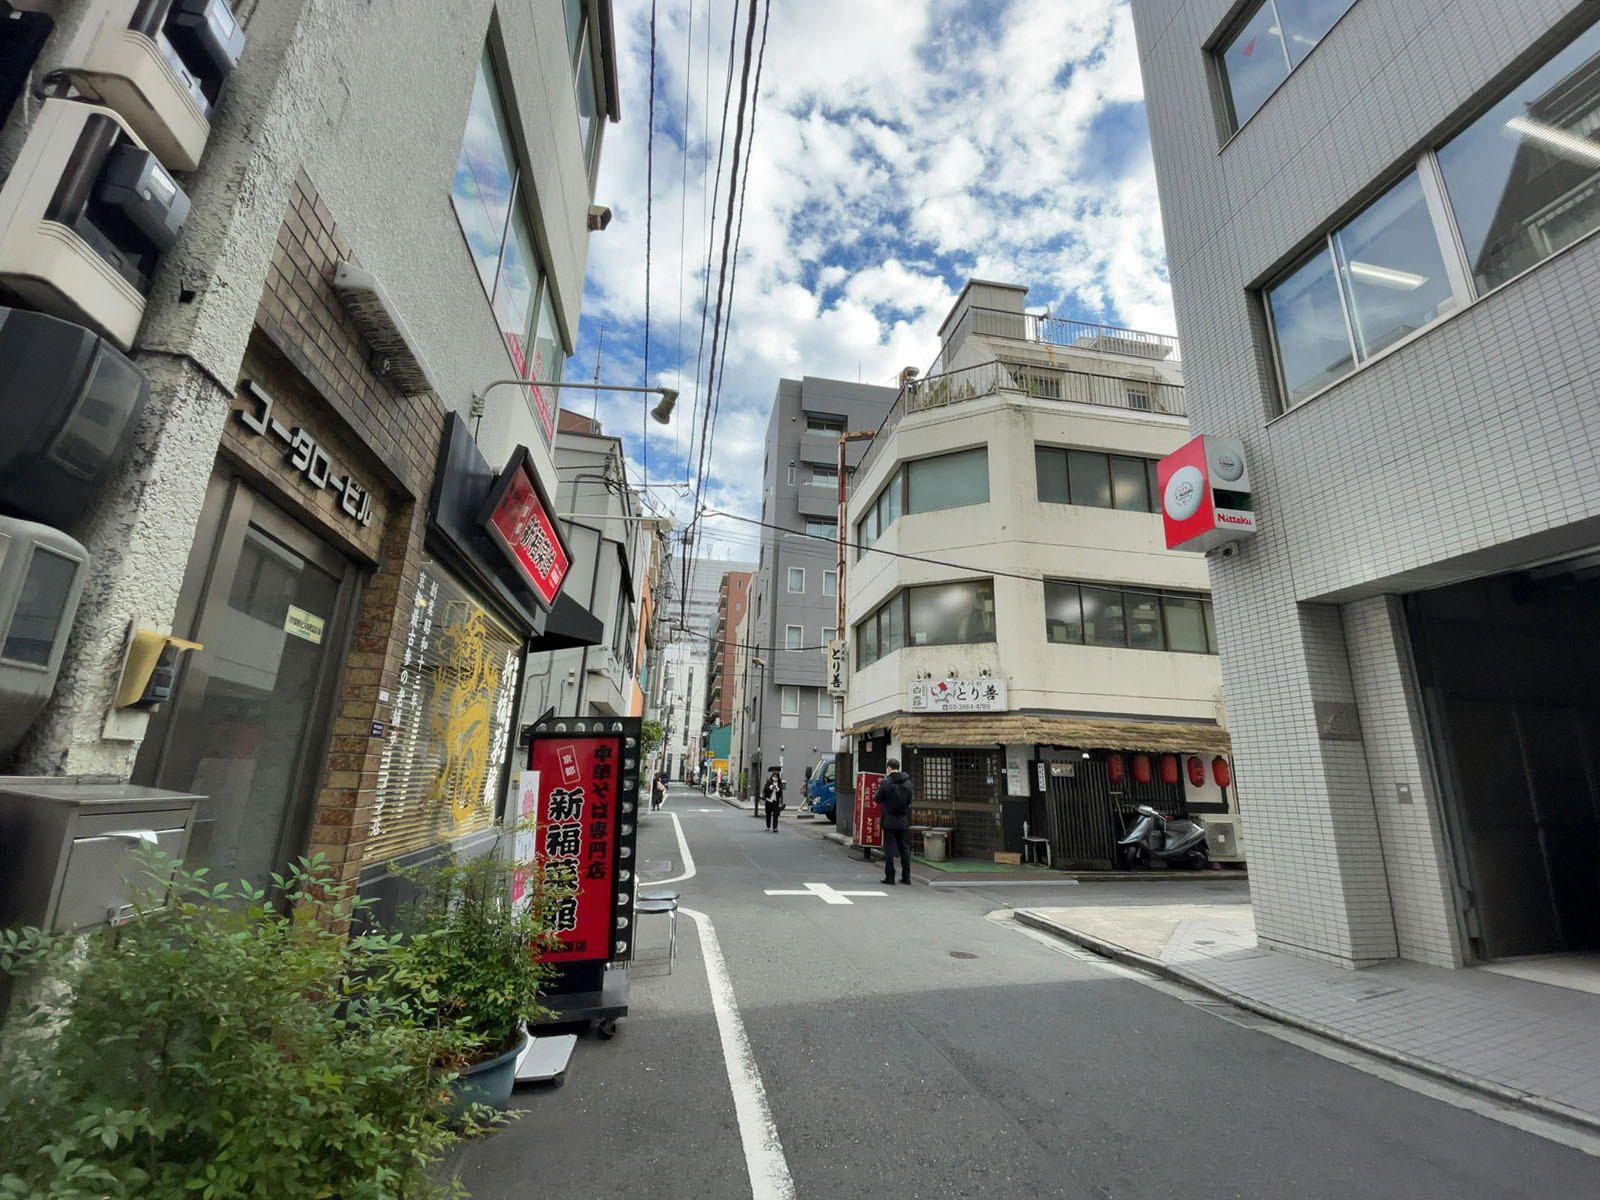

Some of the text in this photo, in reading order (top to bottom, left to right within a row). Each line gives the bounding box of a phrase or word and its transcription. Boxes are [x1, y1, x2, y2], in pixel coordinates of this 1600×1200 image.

[1217, 513, 1253, 526] Nittaku
[830, 647, 843, 688] とり善
[957, 684, 1000, 701] とり善
[562, 754, 577, 778] 京都
[585, 744, 613, 881] 中華そば専門店
